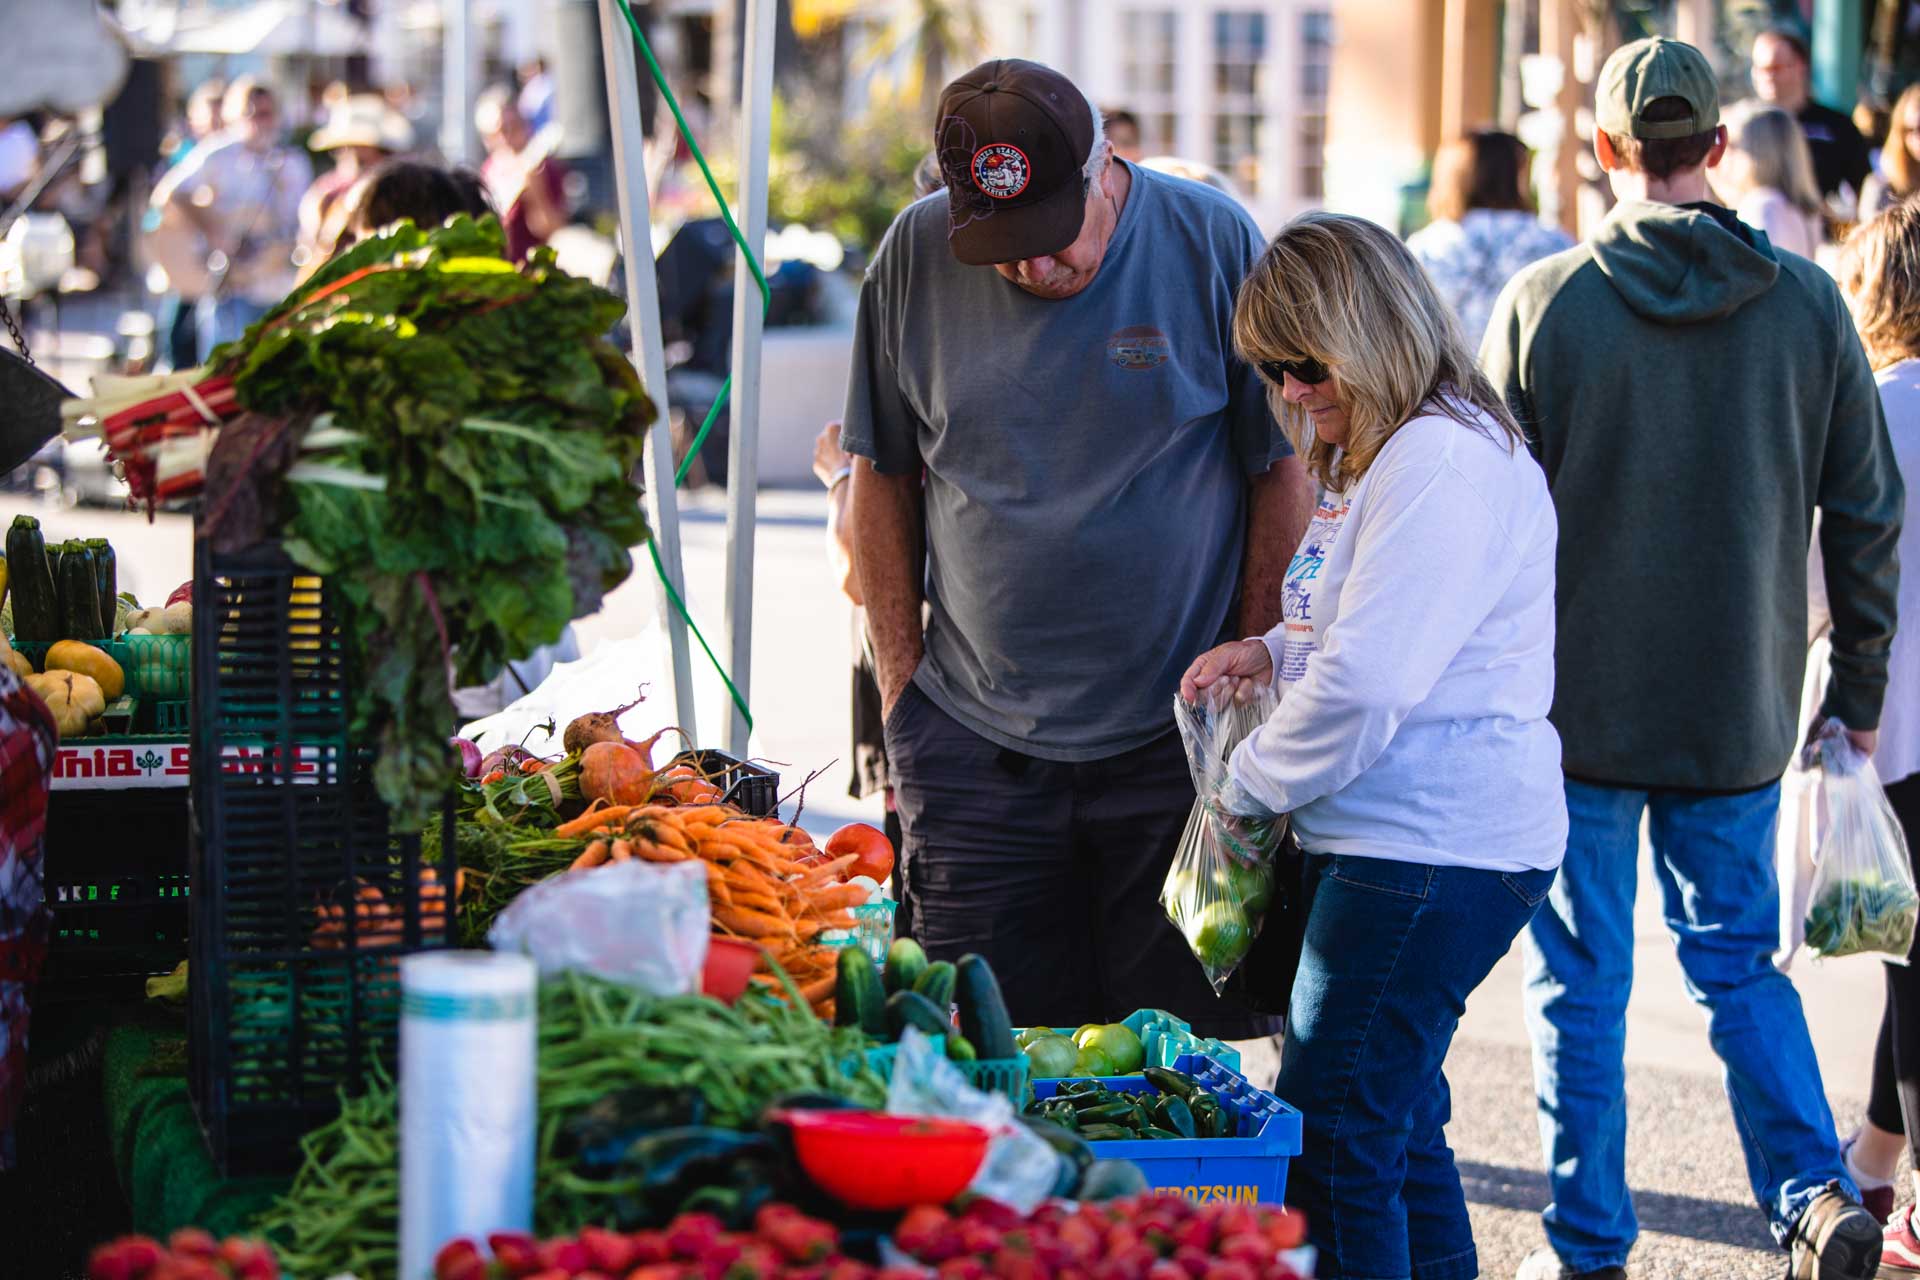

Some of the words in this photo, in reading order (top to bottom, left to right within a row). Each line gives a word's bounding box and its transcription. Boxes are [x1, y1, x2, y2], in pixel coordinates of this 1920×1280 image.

[974, 148, 994, 168] UNITED
[995, 146, 1023, 162] STATES
[981, 182, 1008, 197] MARINE
